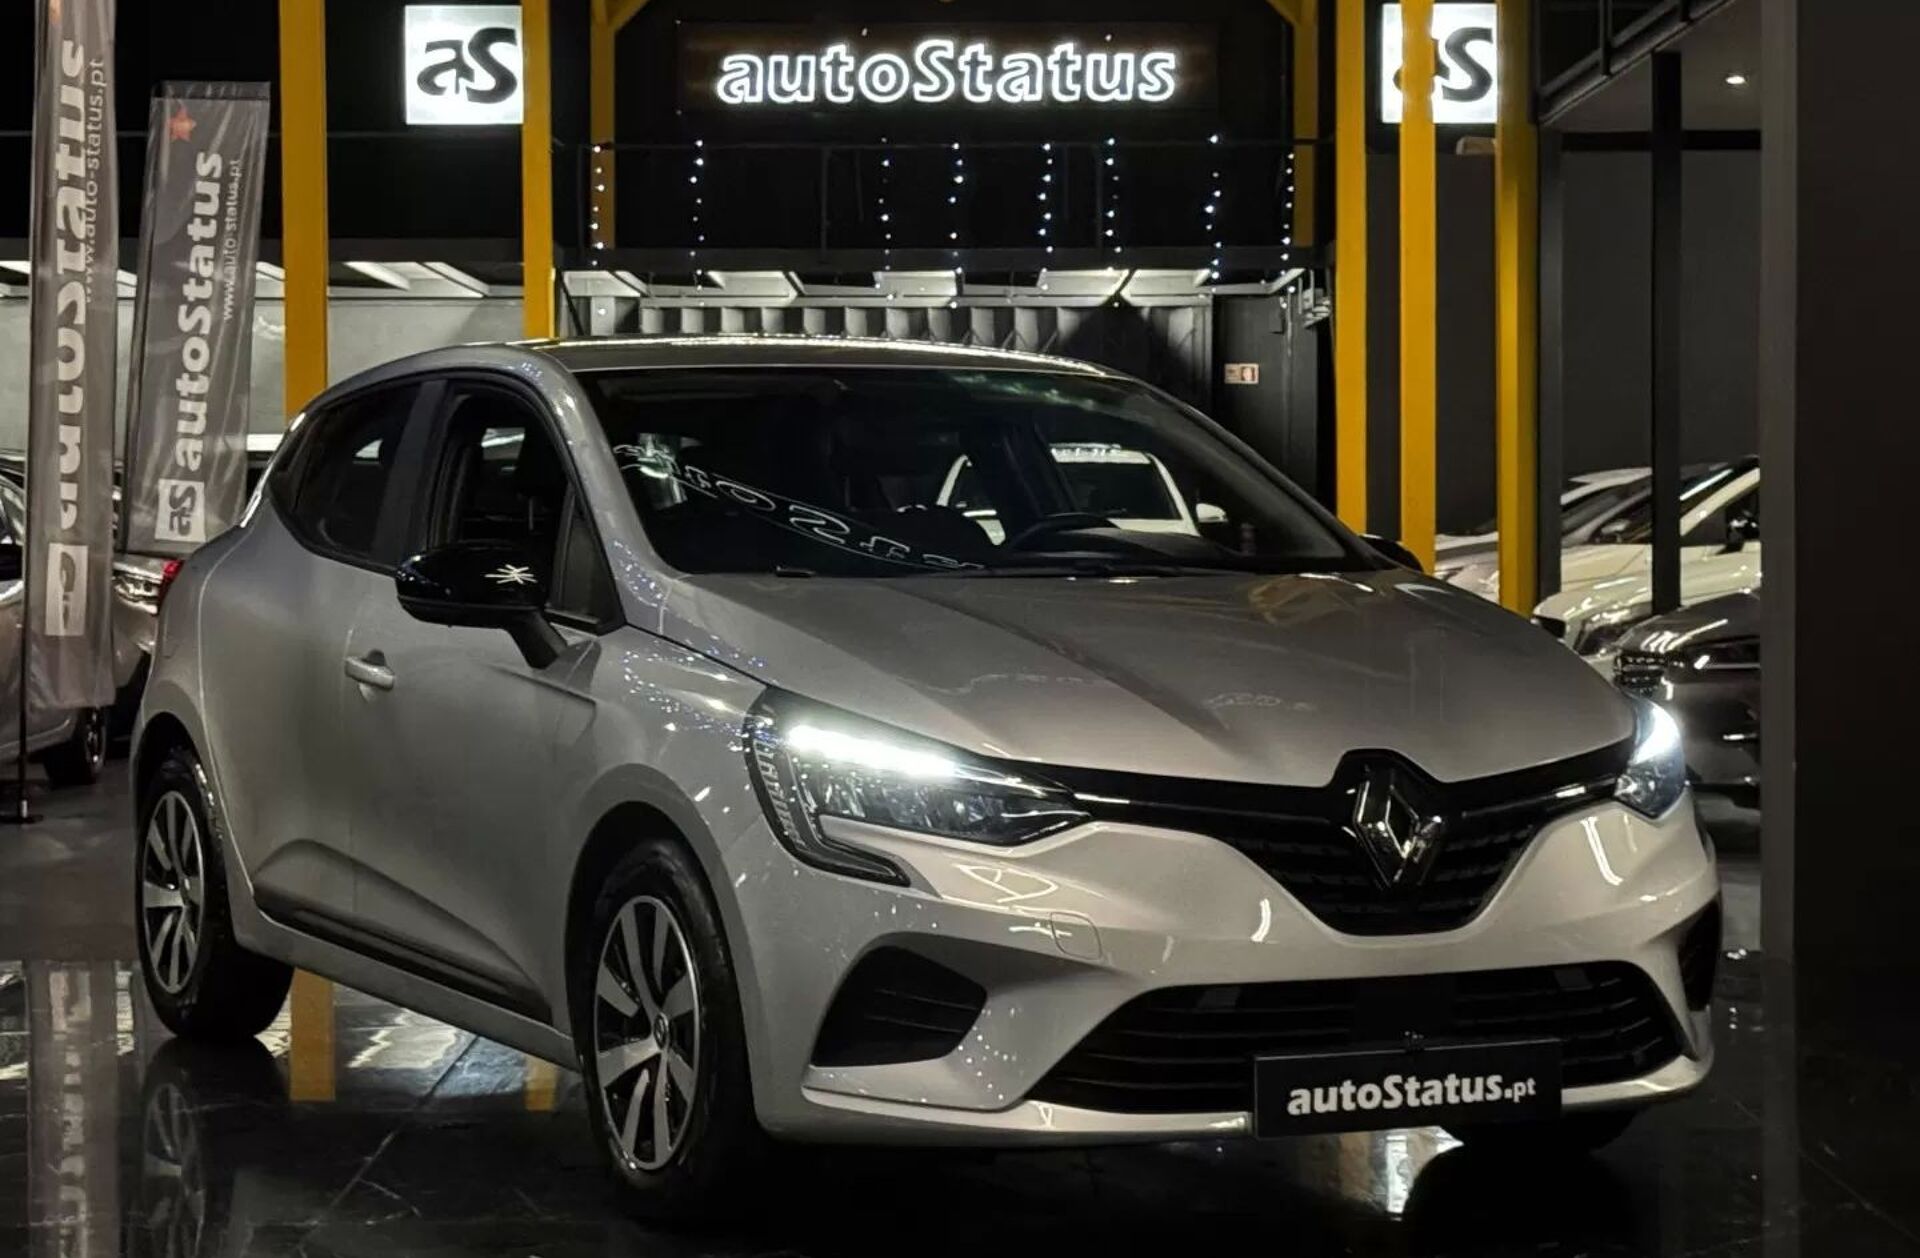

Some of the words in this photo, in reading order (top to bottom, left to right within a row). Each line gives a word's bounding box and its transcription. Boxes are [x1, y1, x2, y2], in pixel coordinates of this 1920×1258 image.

[417, 27, 518, 104] aS
[716, 37, 1178, 104] autoStatus
[1393, 27, 1493, 102] S
[174, 151, 222, 471] autoStatus
[1286, 1073, 1537, 1116] autoStatus.pt
